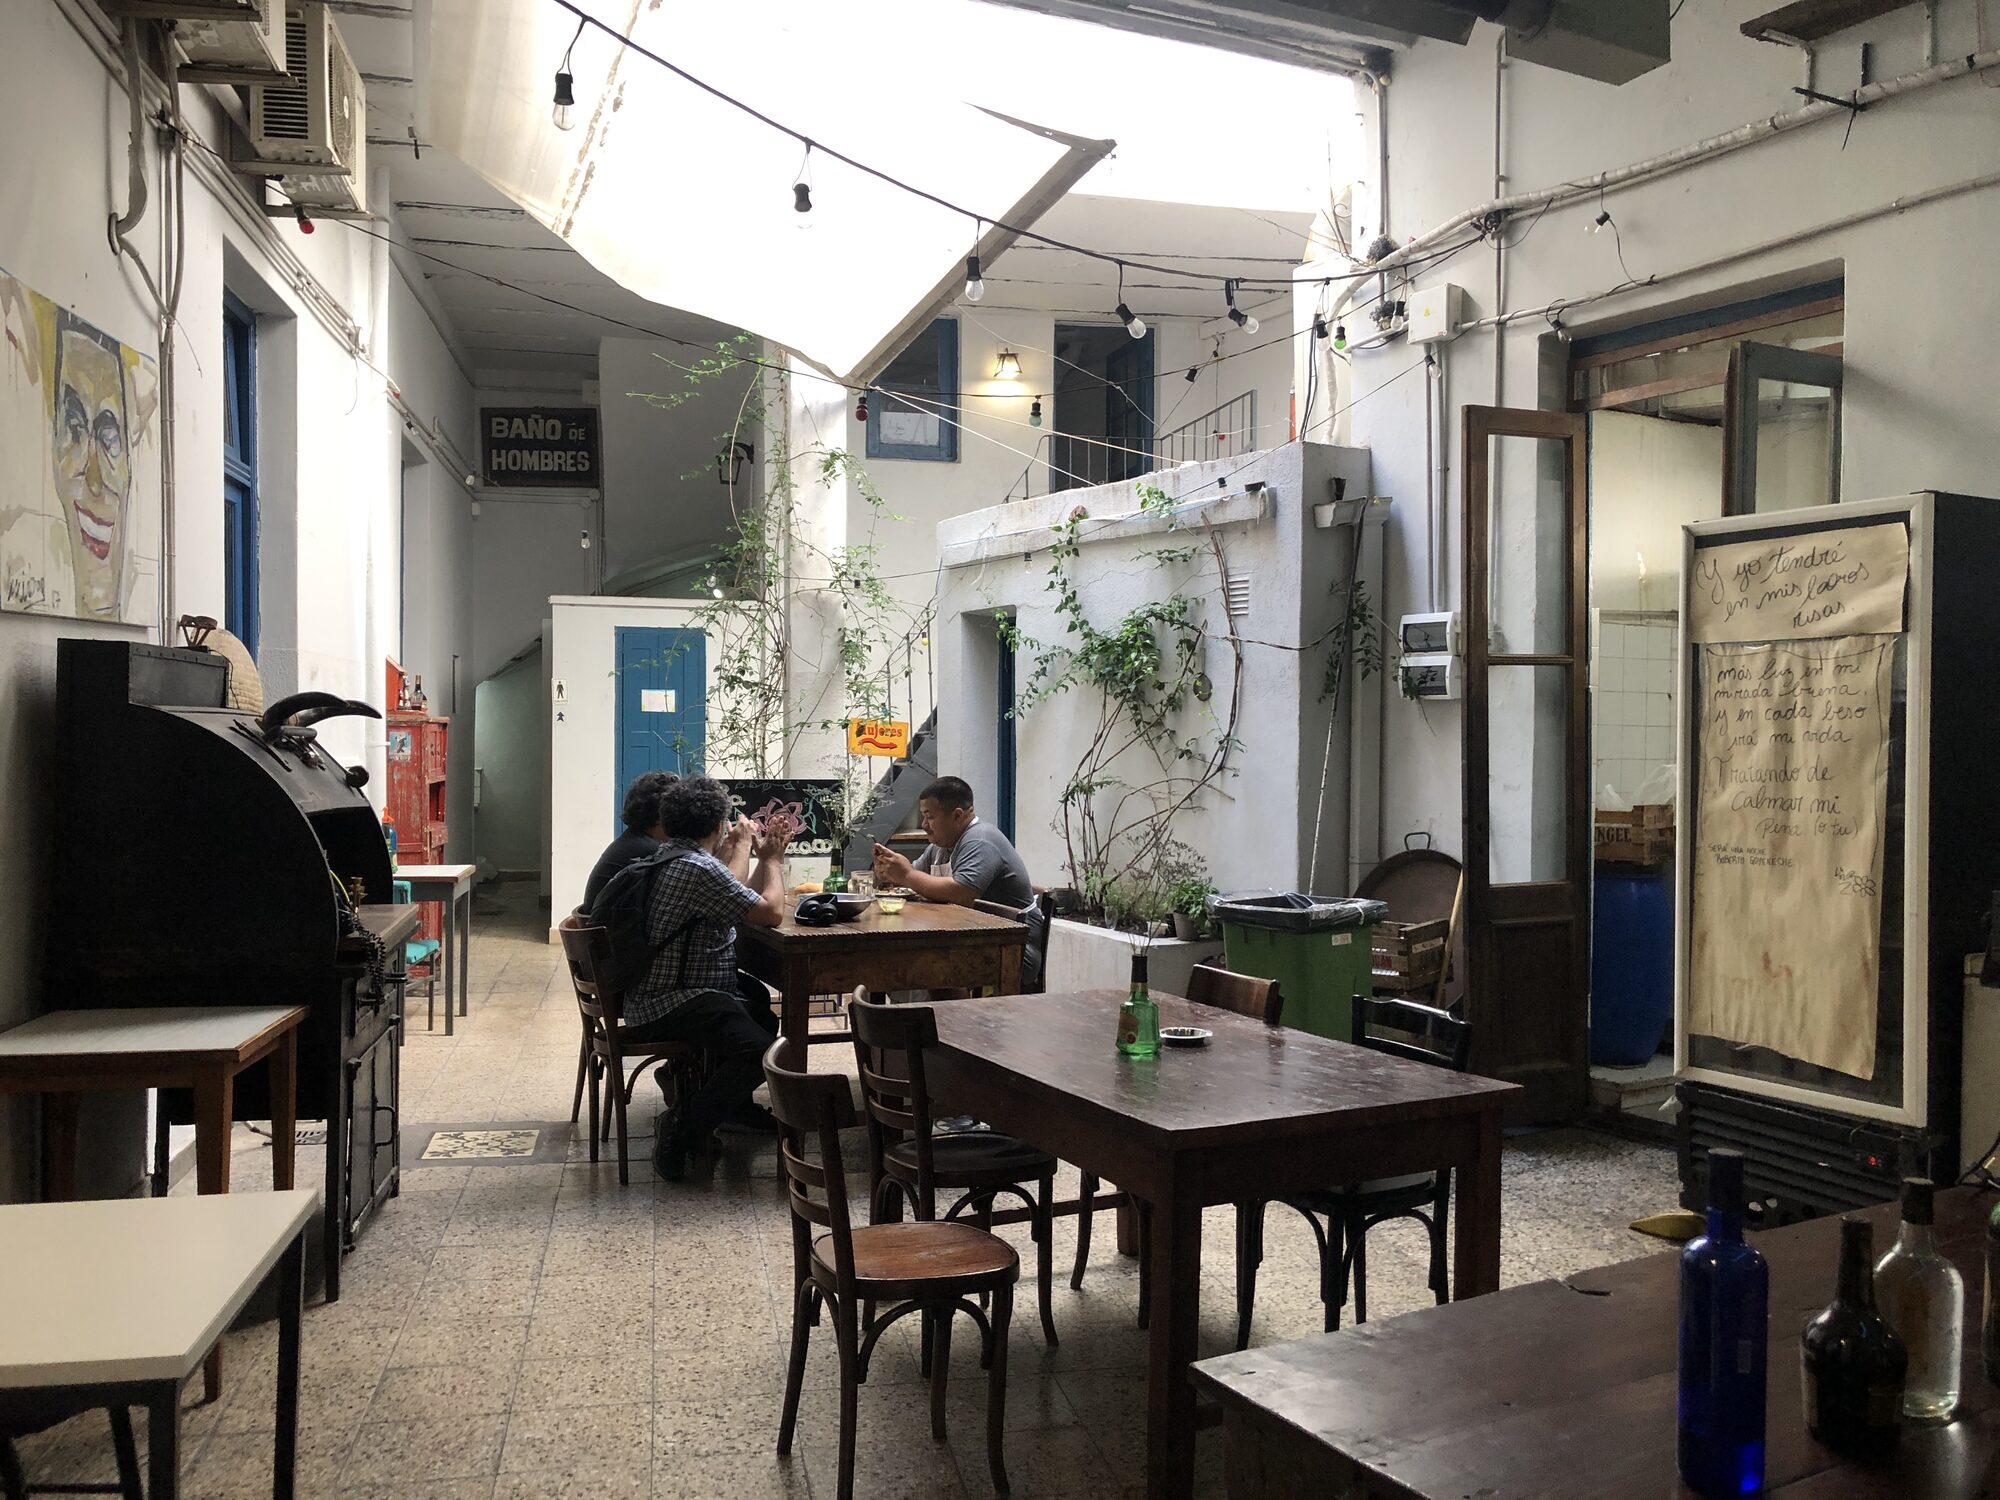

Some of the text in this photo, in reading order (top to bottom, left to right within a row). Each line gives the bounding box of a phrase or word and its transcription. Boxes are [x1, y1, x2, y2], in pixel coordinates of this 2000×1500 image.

[491, 414, 586, 440] BAÑO DE
[491, 449, 590, 472] HOMBRES
[1695, 541, 1847, 604] Y yo tendré
[1724, 597, 1749, 622] en
[1756, 582, 1802, 609] mis
[1717, 664, 1751, 683] más
[1758, 658, 1794, 687] luz
[1833, 663, 1861, 677] mi
[1714, 684, 1772, 701] mirada
[1715, 700, 1867, 736] y en cada beso
[1769, 731, 1796, 743] mi
[1802, 725, 1852, 744] vida
[1709, 753, 1836, 787] Tratando de
[1810, 795, 1840, 814] mi
